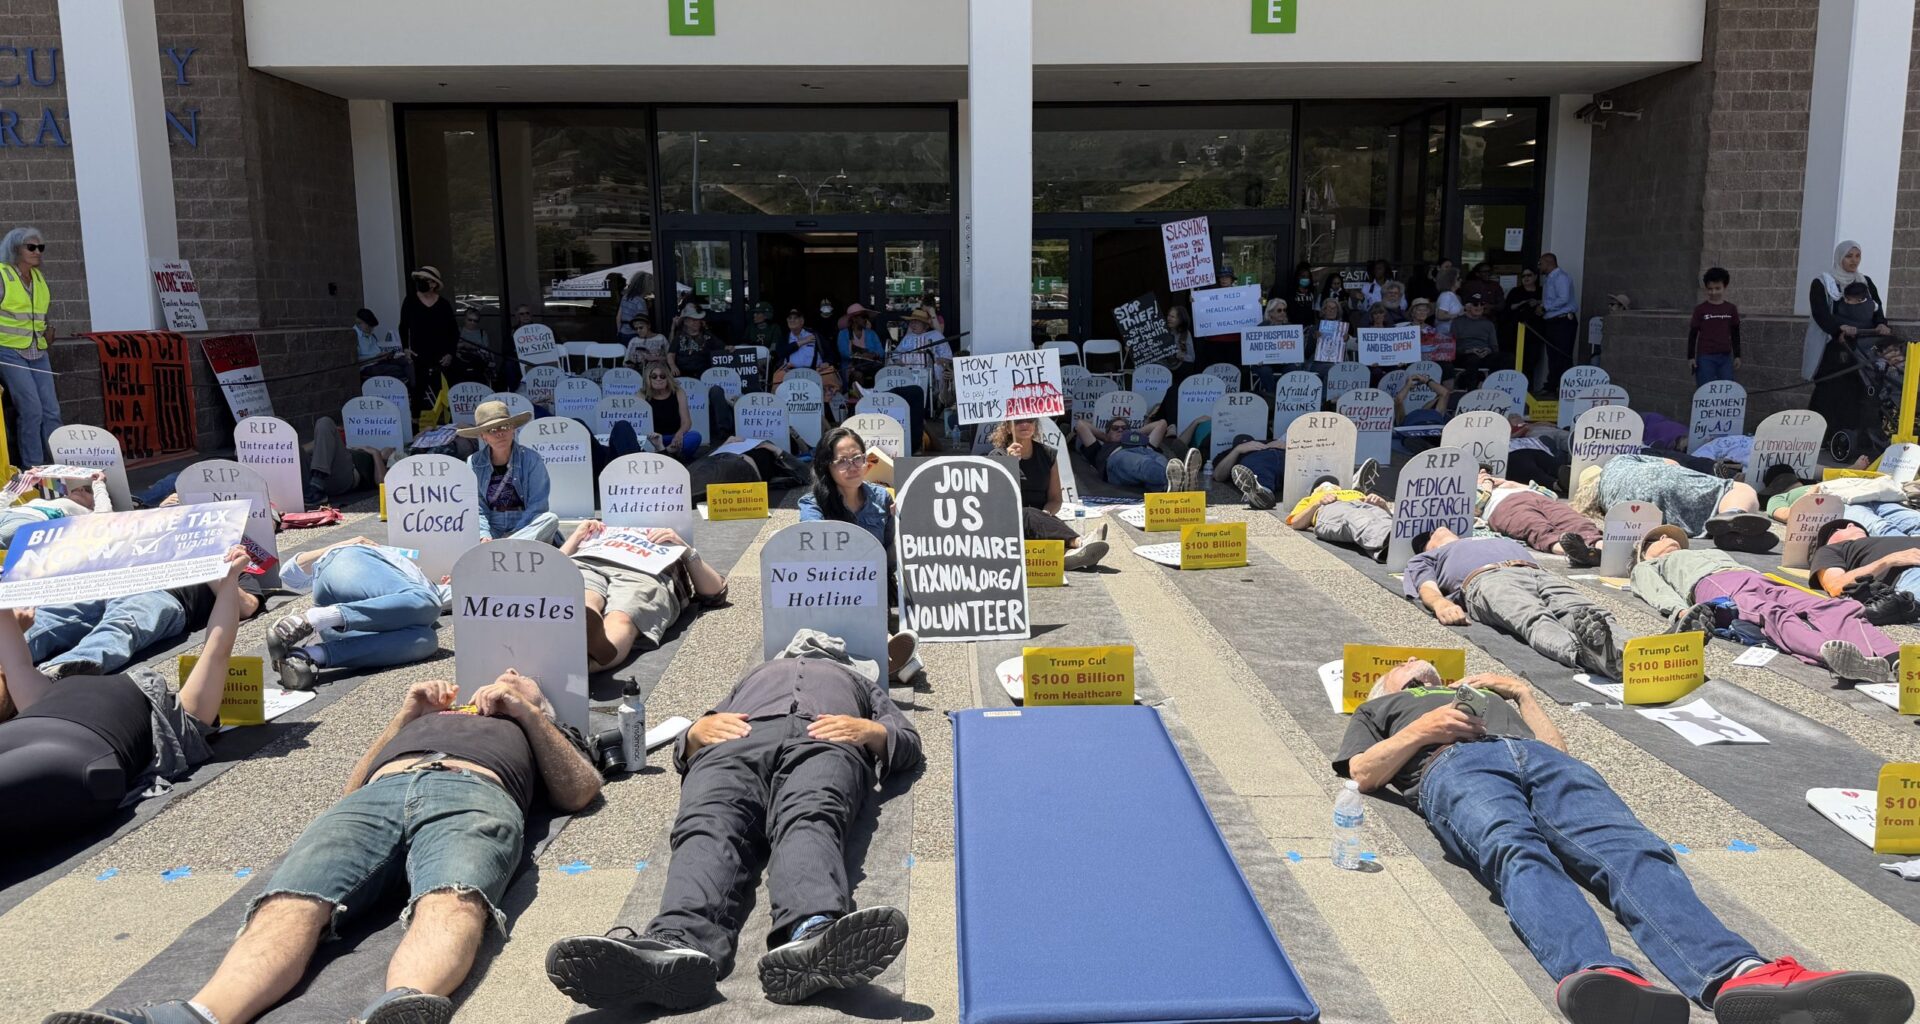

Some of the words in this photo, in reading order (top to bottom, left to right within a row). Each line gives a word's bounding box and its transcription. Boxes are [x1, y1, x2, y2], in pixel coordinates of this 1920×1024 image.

[684, 0, 699, 25] E
[1268, 0, 1281, 23] E
[1166, 217, 1208, 241] SLASHING
[154, 271, 180, 293] MORE
[701, 281, 707, 292] E
[910, 280, 916, 291] E
[1039, 281, 1045, 291] E
[1245, 330, 1263, 341] KEEP
[1263, 329, 1299, 340] HOSPITALS
[1362, 332, 1379, 342] KEEP
[1379, 330, 1416, 342] HOSPITALS
[1250, 341, 1265, 351] AND
[1277, 340, 1296, 350] OPEN
[1366, 342, 1380, 352] AND
[1393, 341, 1412, 351] OPEN
[712, 355, 734, 365] STOP
[740, 353, 756, 363] THE
[960, 356, 993, 372] HOW
[1005, 351, 1046, 368] MANY
[537, 368, 554, 376] RIP
[962, 369, 998, 387] MUST
[1011, 365, 1049, 386] DIE
[1497, 373, 1517, 382] RIP
[1575, 368, 1598, 378] RIP
[103, 362, 145, 396] WELL
[1290, 374, 1310, 383] RIP
[568, 381, 588, 390] RIP
[1709, 383, 1733, 394] RIP
[962, 390, 970, 398] to
[972, 390, 985, 401] pay
[988, 387, 999, 397] for
[1279, 384, 1308, 397] Afraid
[1310, 386, 1321, 401] of
[1354, 391, 1380, 401] RIP
[1476, 390, 1501, 401] RIP
[1591, 387, 1617, 397] RIP
[612, 398, 636, 408] RIP
[752, 396, 774, 406] RIP
[872, 397, 895, 406] RIP
[1111, 393, 1134, 404] RIP
[1229, 395, 1254, 406] RIP
[1693, 398, 1745, 409] TREATMENT
[109, 400, 124, 421] IN
[132, 400, 145, 421] A
[359, 400, 384, 410] RIP
[1006, 396, 1063, 417] BALLROOM
[1111, 405, 1132, 417] UN
[1277, 402, 1316, 412] VACCINES
[600, 410, 648, 419] Untreated
[741, 408, 782, 417] Believed
[1339, 404, 1393, 420] Caregiver
[1596, 411, 1626, 423] RIP
[1700, 408, 1741, 419] DENIED
[348, 416, 360, 425] No
[364, 416, 398, 425] Suicide
[857, 418, 886, 430] RIP
[1308, 416, 1338, 429] RIP
[1464, 415, 1494, 429] RIP
[1780, 414, 1811, 426] RIP
[250, 421, 277, 434] RIP
[356, 426, 392, 437] Hotline
[538, 421, 569, 436] RIP
[1583, 426, 1632, 440] DENIED
[1693, 421, 1707, 439] by
[68, 429, 98, 441] RIP
[239, 440, 293, 451] Untreated
[531, 443, 546, 452] No
[548, 442, 580, 451] Access
[1573, 440, 1642, 461] Mifepristone
[1753, 437, 1817, 456] criminalizing
[57, 447, 82, 455] Can't
[85, 447, 117, 458] Afford
[64, 458, 115, 467] Insurance
[241, 454, 295, 465] Addiction
[1425, 453, 1461, 470] RIP
[1758, 451, 1807, 469] MENTAL
[411, 460, 451, 477] RIP
[628, 459, 665, 475] RIP
[203, 467, 241, 483] RIP
[934, 465, 989, 495] JOIN
[607, 483, 684, 497] Untreated
[1406, 476, 1465, 497] MEDICAL
[392, 483, 464, 504] CLINIC
[712, 497, 734, 505] $100
[607, 501, 685, 514] Addiction
[932, 495, 984, 532] US
[1148, 508, 1171, 516] $100
[1400, 497, 1470, 519] RESEARCH
[402, 508, 470, 534] Closed
[1796, 512, 1838, 523] Denied
[27, 513, 180, 547] BILLIONAIRE
[187, 508, 229, 529] TAX
[1395, 517, 1469, 539] DEFUNDED
[1623, 520, 1643, 530] Not
[174, 532, 200, 543] VOTE
[202, 528, 223, 539] YES
[799, 531, 851, 551] RIP
[604, 539, 652, 558] OPEN
[902, 534, 1021, 560] BILLIONAIRE
[1185, 541, 1209, 551] $100
[1212, 540, 1242, 549] Billion
[1204, 551, 1240, 559] Healthcare
[489, 550, 545, 574] RIP
[771, 567, 798, 583] No
[806, 566, 878, 582] Suicide
[904, 563, 1022, 592] TAXNOW.ORG/
[788, 591, 862, 608] Hotline
[462, 595, 575, 621] Measles
[908, 599, 1026, 632] VOLUNTEER
[1638, 647, 1671, 656] Trump
[1673, 644, 1689, 653] Cut
[1049, 658, 1085, 668] Trump
[1087, 657, 1106, 666] Cut
[1628, 661, 1659, 672] $100
[1663, 658, 1699, 669] Billion
[228, 667, 248, 677] Cut
[1628, 676, 1650, 684] from
[1652, 672, 1699, 683] Healthcare
[1031, 673, 1070, 685] $100
[1076, 672, 1125, 684] Billion
[1034, 691, 1059, 700] from
[1062, 690, 1122, 700] Healthcare
[1883, 816, 1915, 826] from
